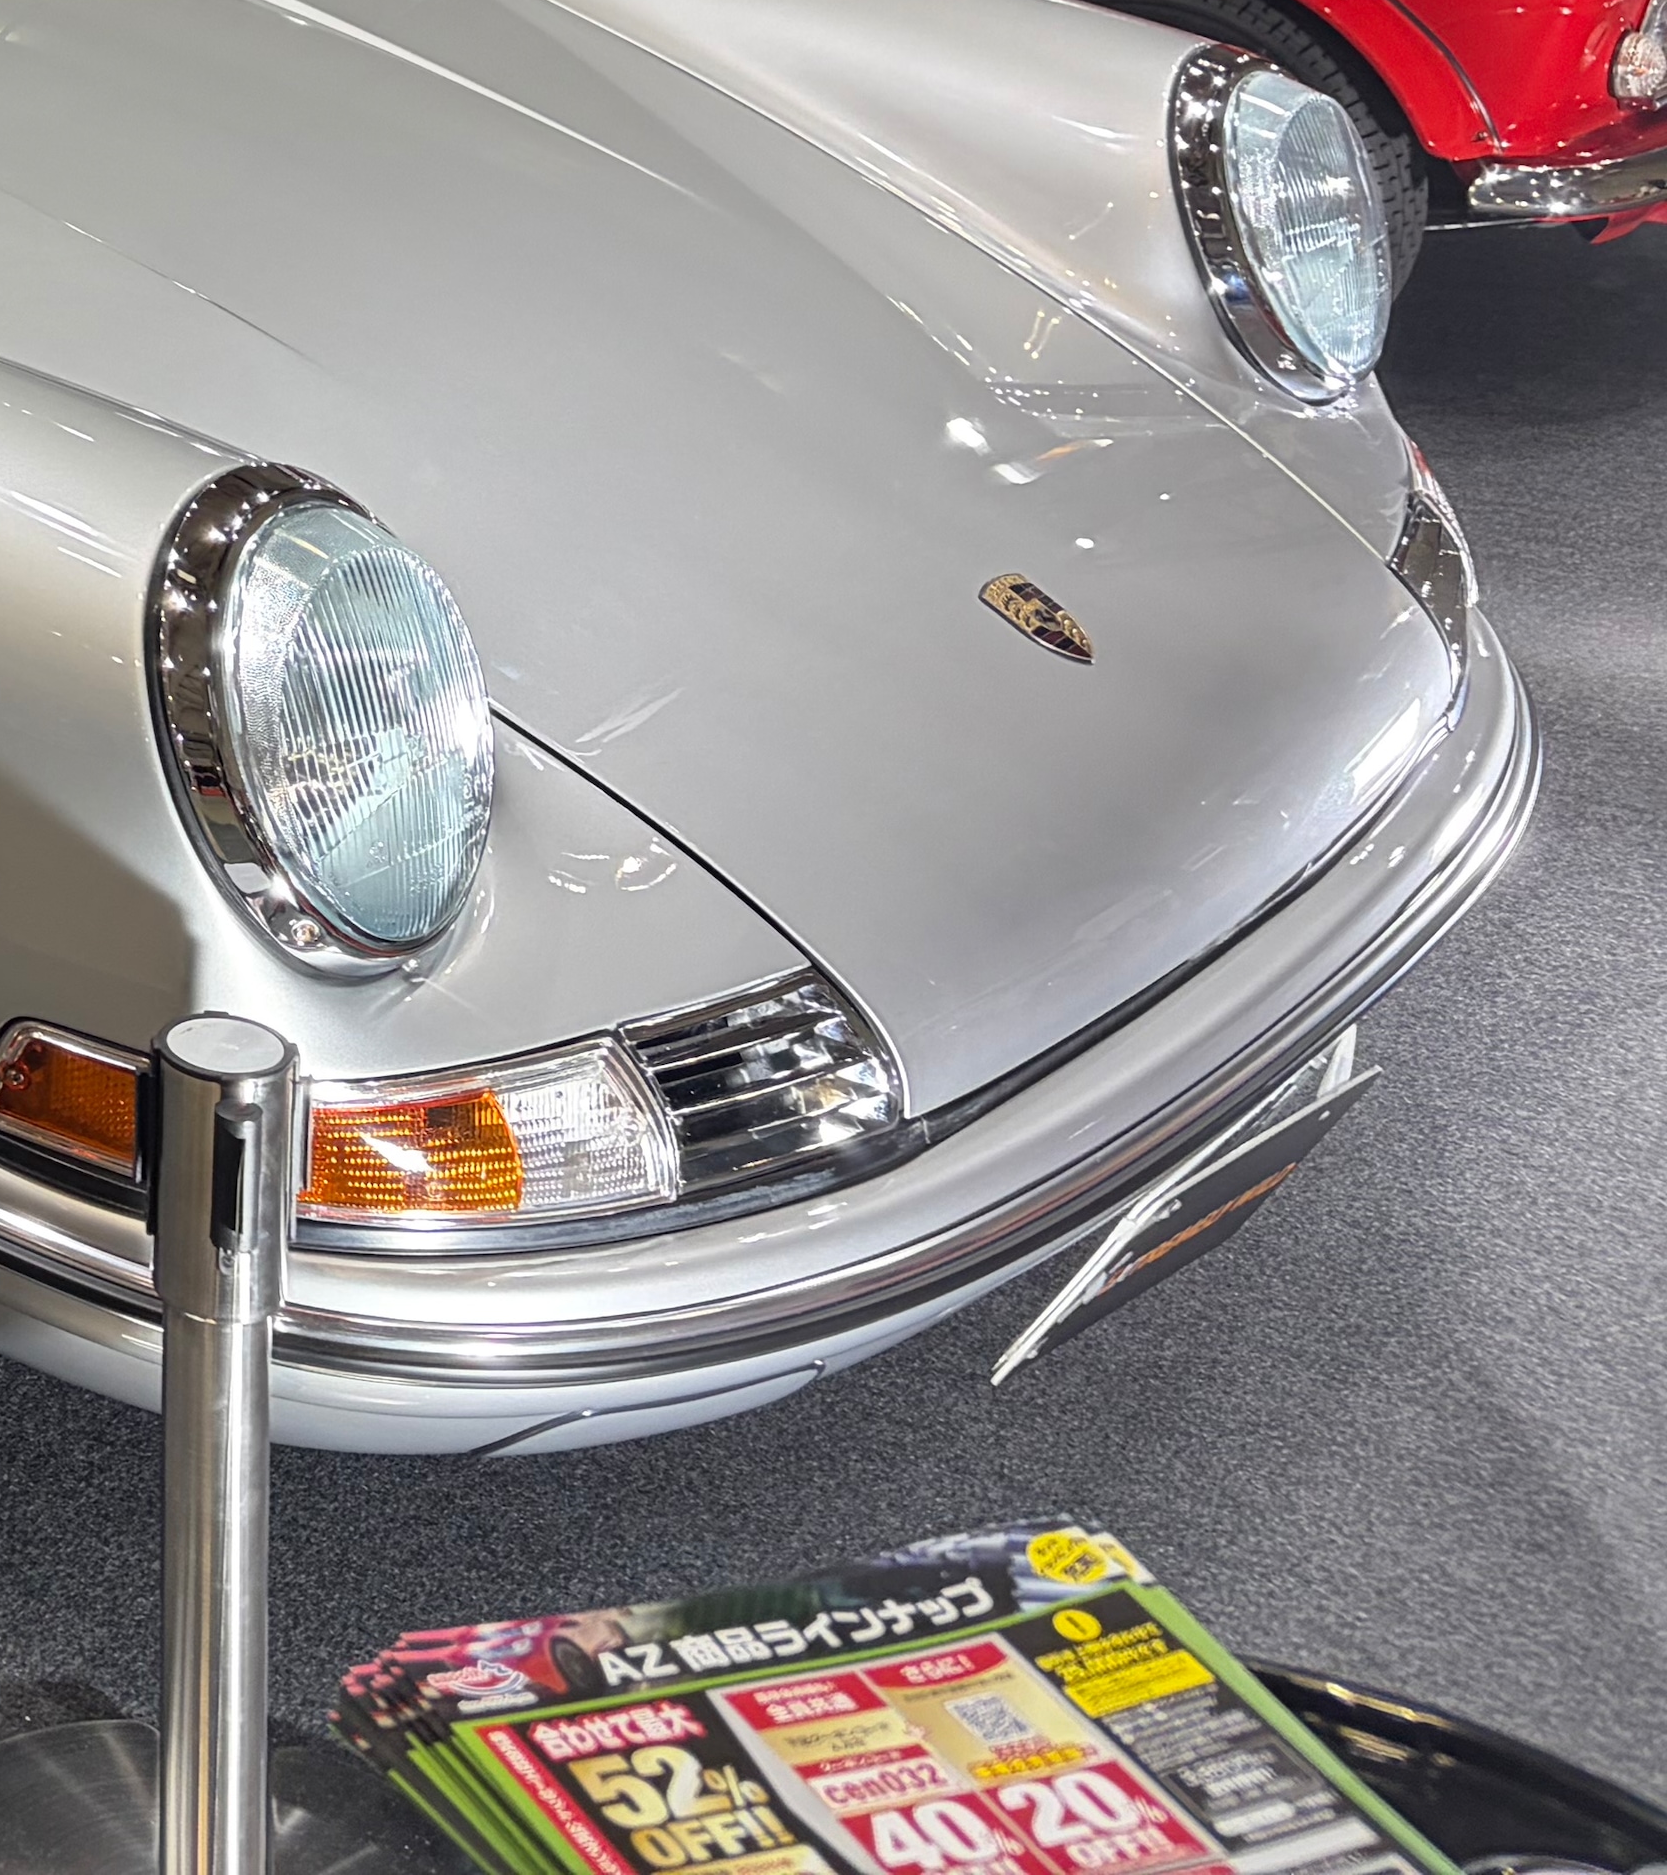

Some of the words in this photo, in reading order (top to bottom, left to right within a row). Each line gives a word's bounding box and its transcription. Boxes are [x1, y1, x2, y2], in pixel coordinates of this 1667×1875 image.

[598, 1644, 681, 1688] AZ
[531, 1702, 708, 1762] 合わせて最大
[570, 1745, 770, 1830] 52%
[997, 1769, 1167, 1849] 20%
[630, 1805, 798, 1867] OFF!!
